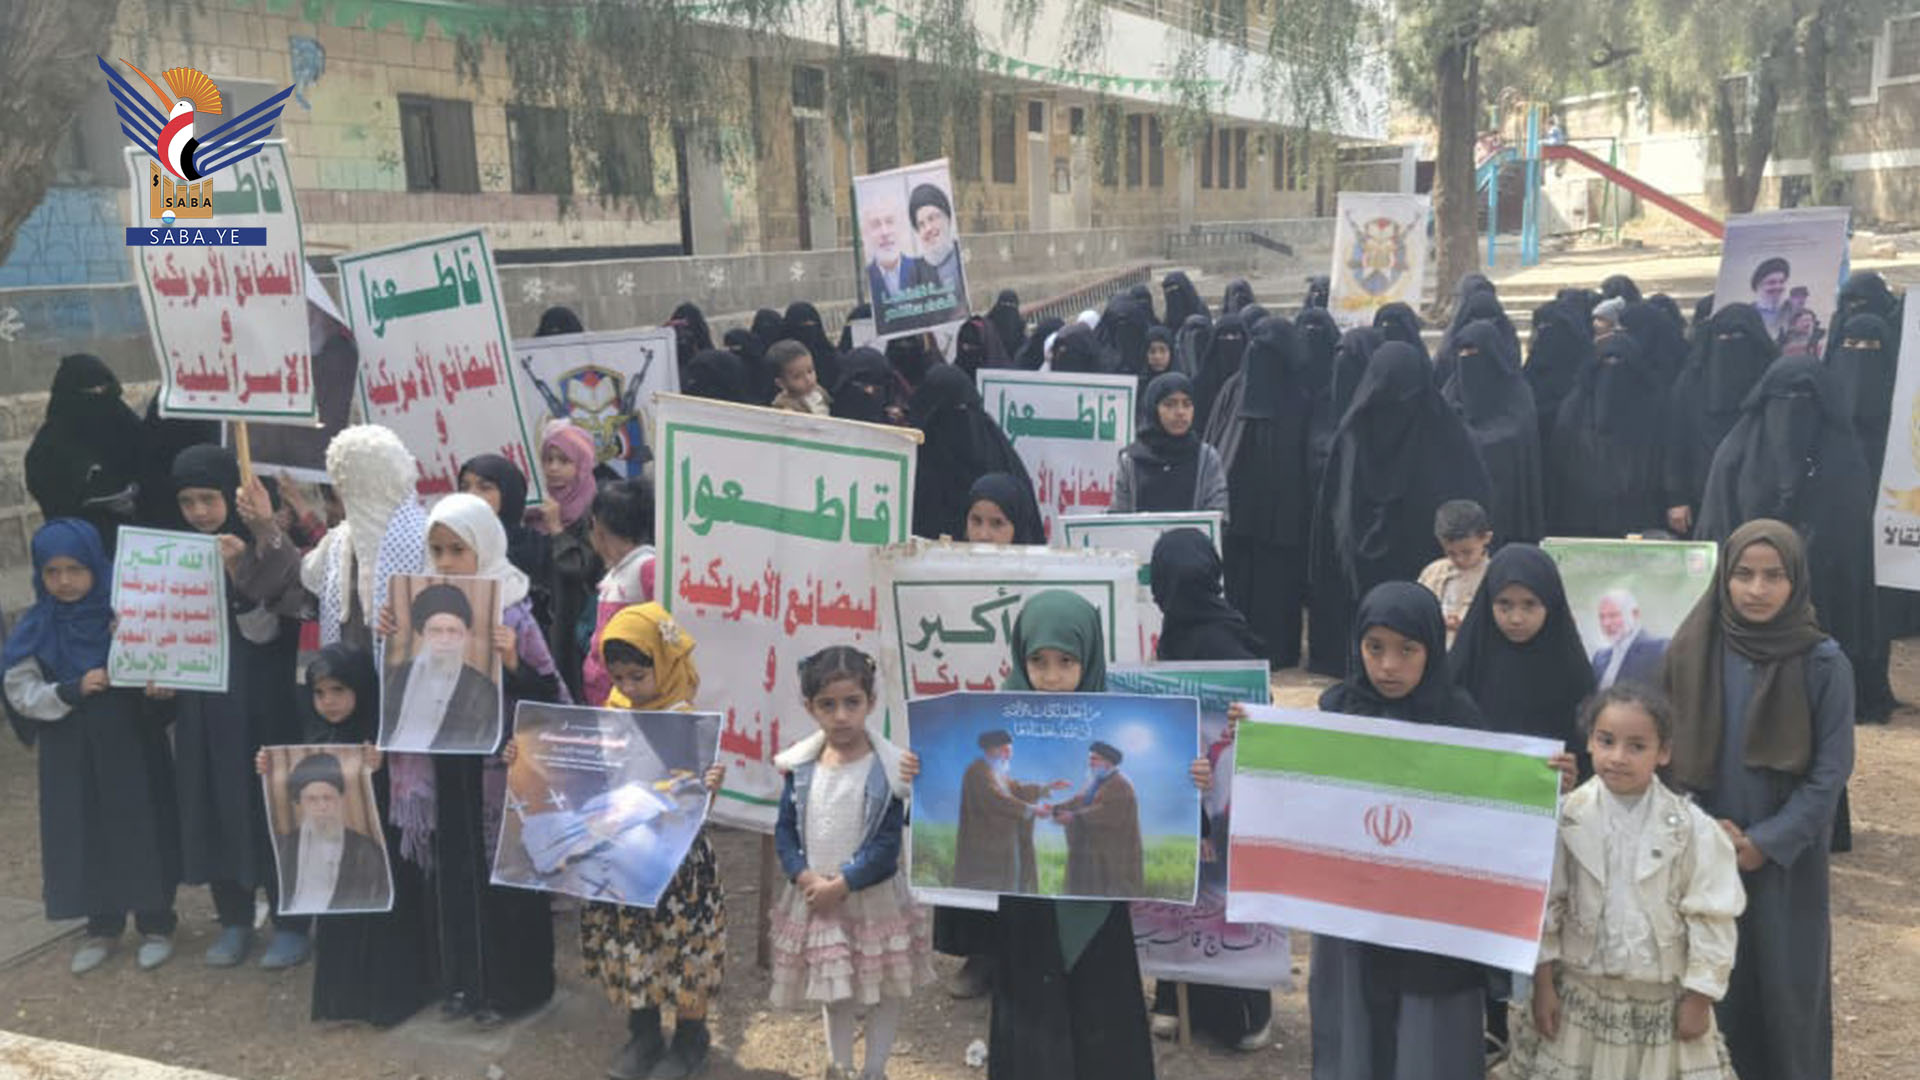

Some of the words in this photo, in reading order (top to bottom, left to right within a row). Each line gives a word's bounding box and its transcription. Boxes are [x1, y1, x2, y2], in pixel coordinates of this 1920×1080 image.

[234, 251, 299, 305] البضائع
[360, 246, 482, 339] قاطعوا
[439, 341, 505, 405] البضائع
[998, 389, 1117, 447] قاطعوا
[681, 454, 892, 547] قاطعوا
[678, 554, 782, 622] الأمريكية
[907, 586, 1021, 659] أكبر
